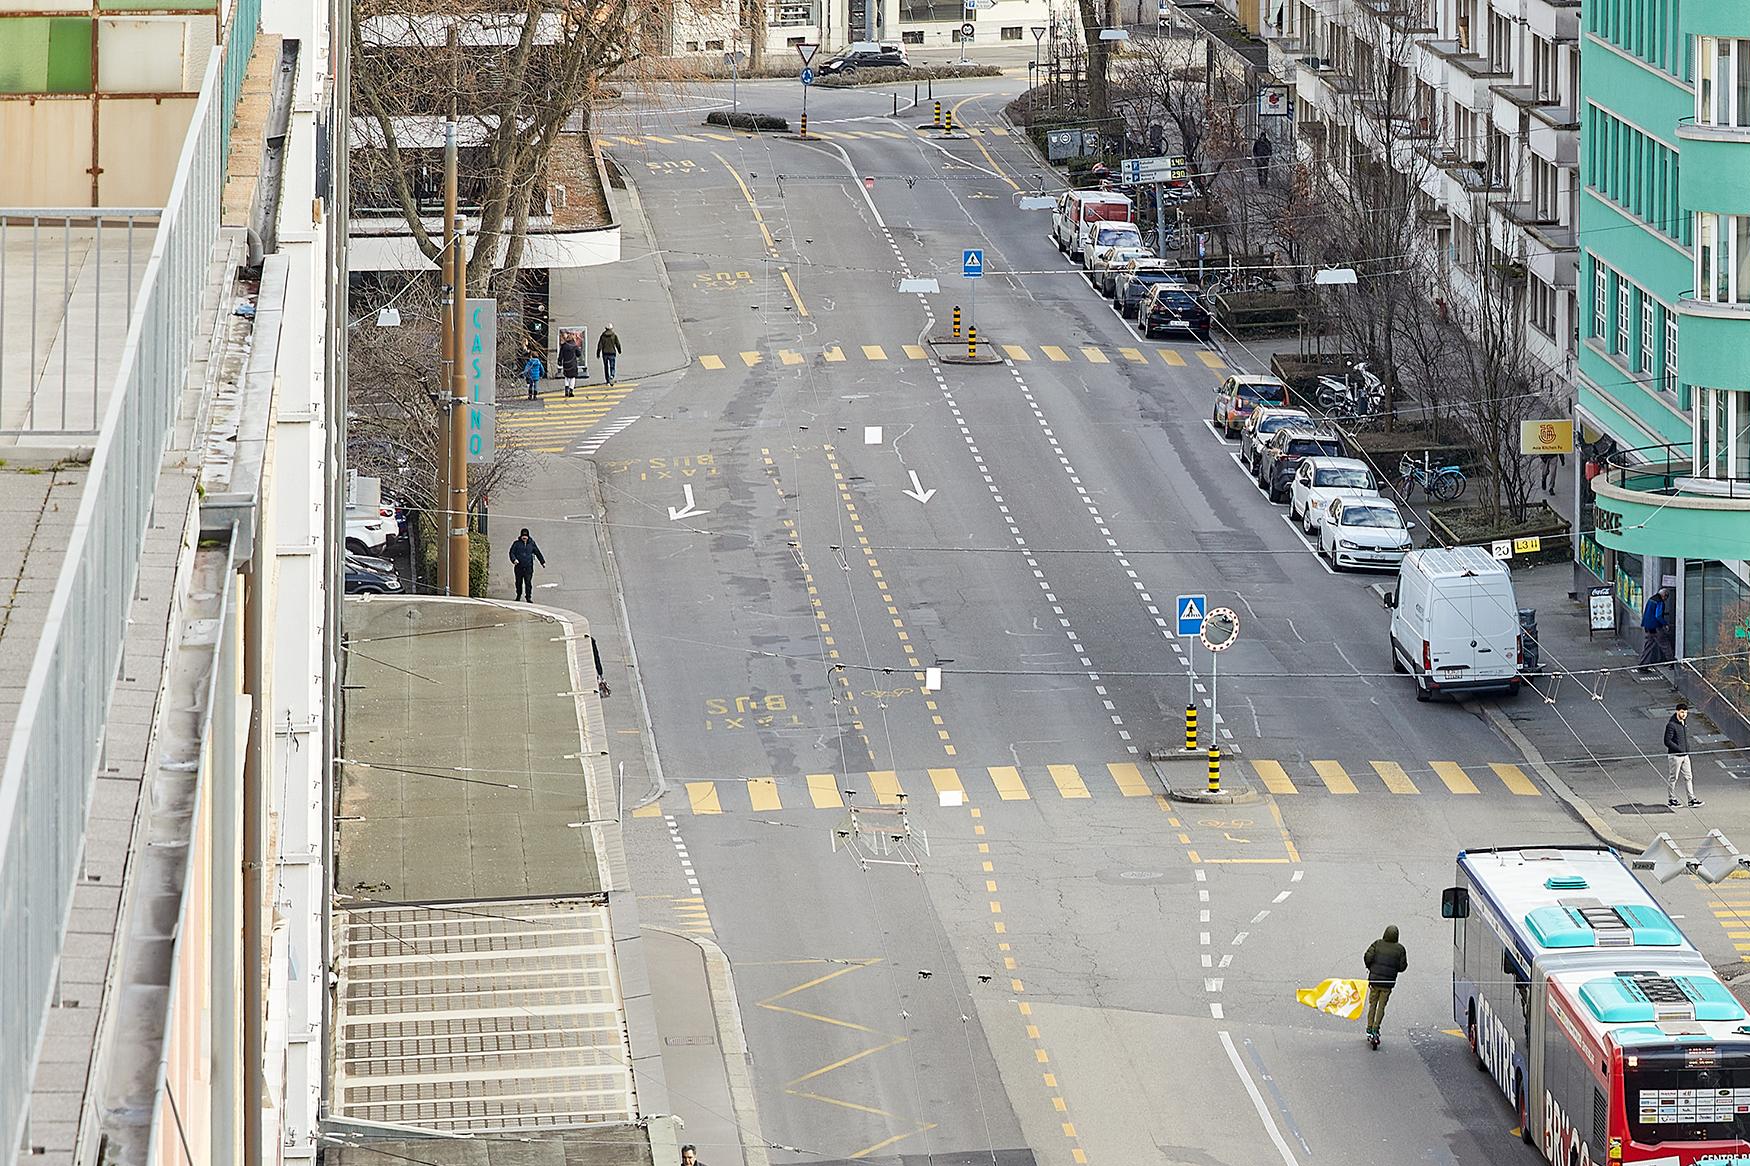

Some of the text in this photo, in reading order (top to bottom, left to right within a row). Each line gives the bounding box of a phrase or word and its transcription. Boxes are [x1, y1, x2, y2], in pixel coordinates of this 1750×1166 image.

[696, 271, 751, 283] BUS
[470, 308, 482, 455] CASINO
[1477, 992, 1516, 1110] CENTRE
